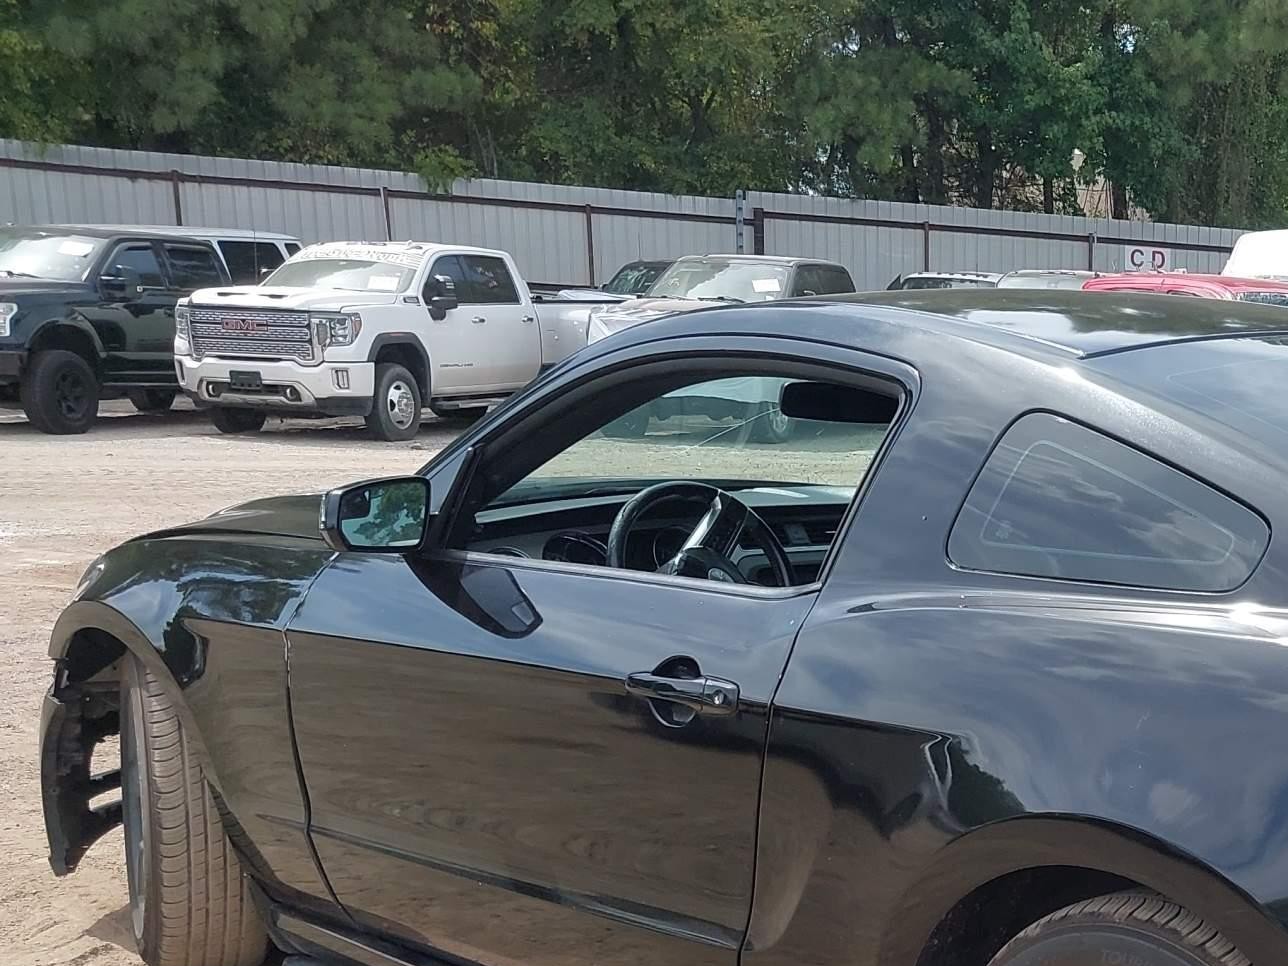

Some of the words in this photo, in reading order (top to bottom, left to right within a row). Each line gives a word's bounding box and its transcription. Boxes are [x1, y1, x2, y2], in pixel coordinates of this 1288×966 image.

[1130, 249, 1144, 268] C
[1151, 250, 1166, 269] D
[223, 319, 267, 332] GMC
